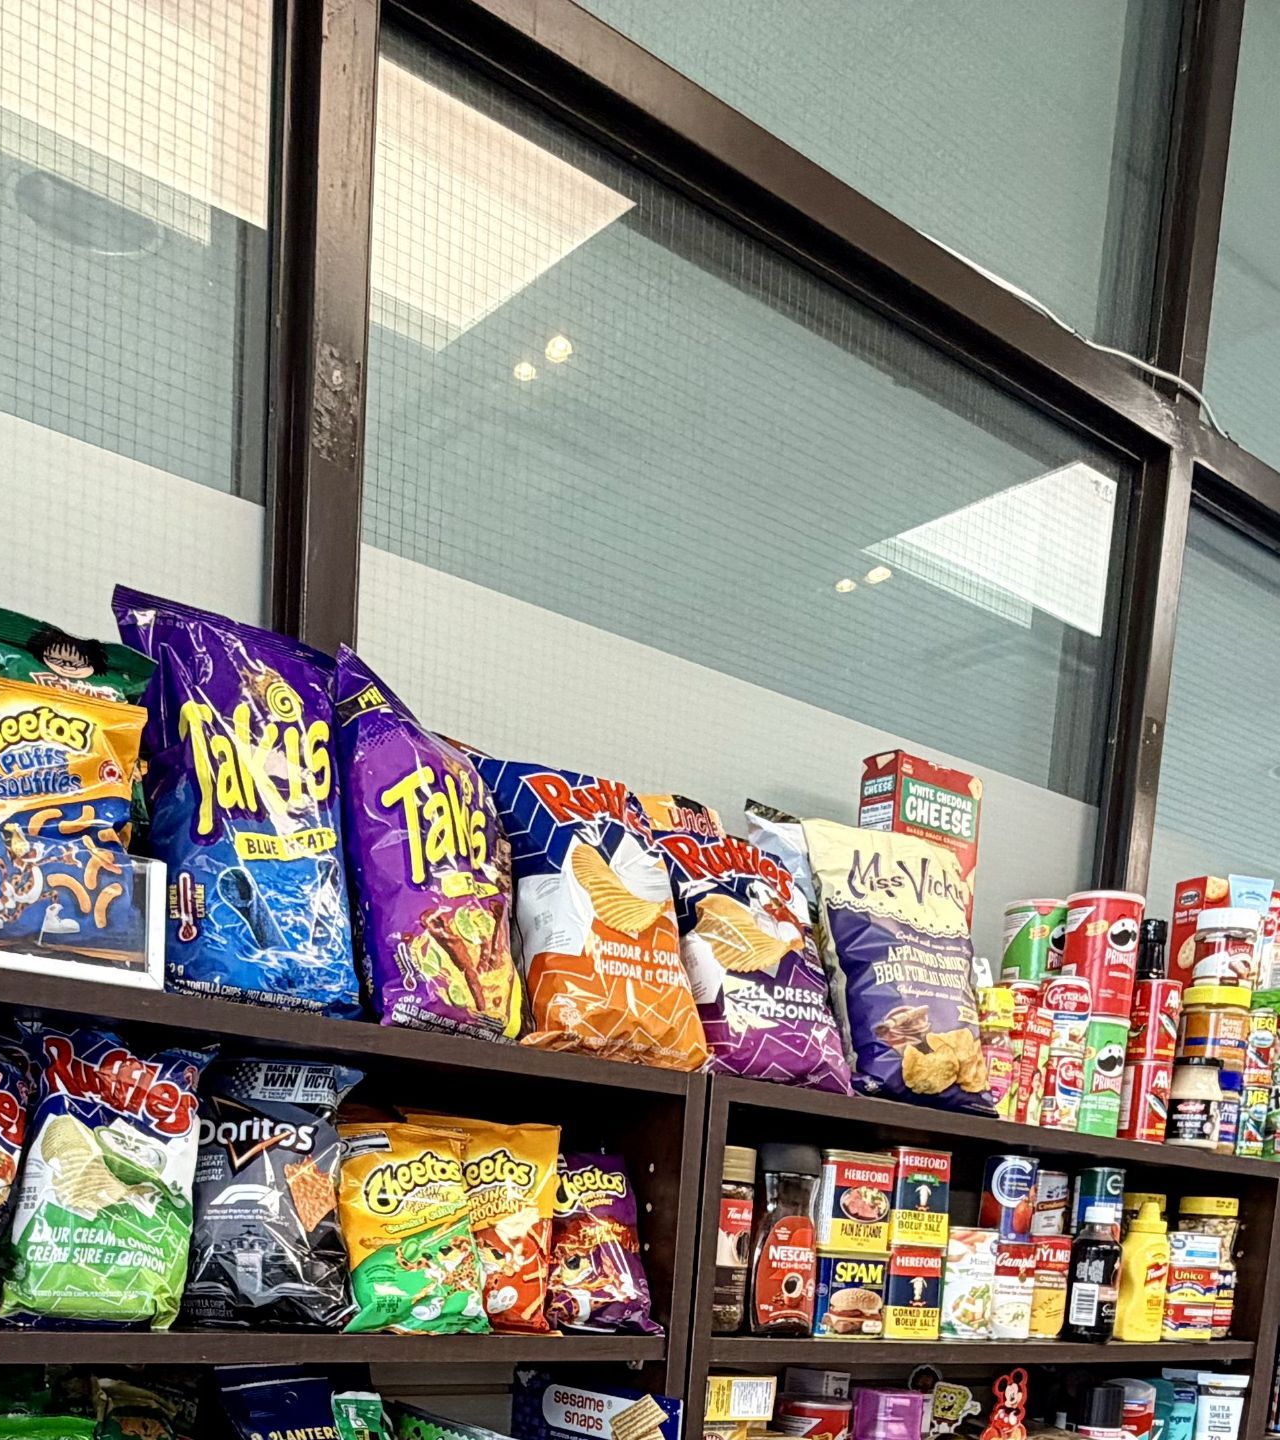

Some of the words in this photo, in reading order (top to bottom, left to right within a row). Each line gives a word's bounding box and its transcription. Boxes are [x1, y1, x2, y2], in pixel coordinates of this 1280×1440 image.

[181, 681, 333, 836] Takis
[908, 782, 936, 801] WHITE
[937, 789, 973, 812] CHEDDAR
[382, 766, 488, 885] Takis
[905, 796, 973, 837] CHEESE
[247, 838, 281, 858] BLUE
[660, 835, 795, 903] Ruffles
[848, 850, 903, 899] Miss
[593, 940, 641, 959] CHEDDAR
[594, 958, 643, 978] CHEDDAR
[873, 964, 902, 985] BBQ
[43, 1035, 199, 1137] Ruffles
[263, 1072, 299, 1089] WIN
[198, 1118, 317, 1152] Doritos
[900, 1154, 948, 1170] HEREFORD
[366, 1154, 462, 1214] Cheetos
[844, 1168, 889, 1184] HEREFORD
[73, 1225, 117, 1245] CREAM
[72, 1247, 102, 1265] SURE
[104, 1253, 116, 1263] ET
[896, 1255, 942, 1269] HEREFORD
[835, 1261, 884, 1284] SPAM
[1173, 1270, 1205, 1282] Unico
[553, 1390, 605, 1413] sesame
[564, 1409, 603, 1432] snaps
